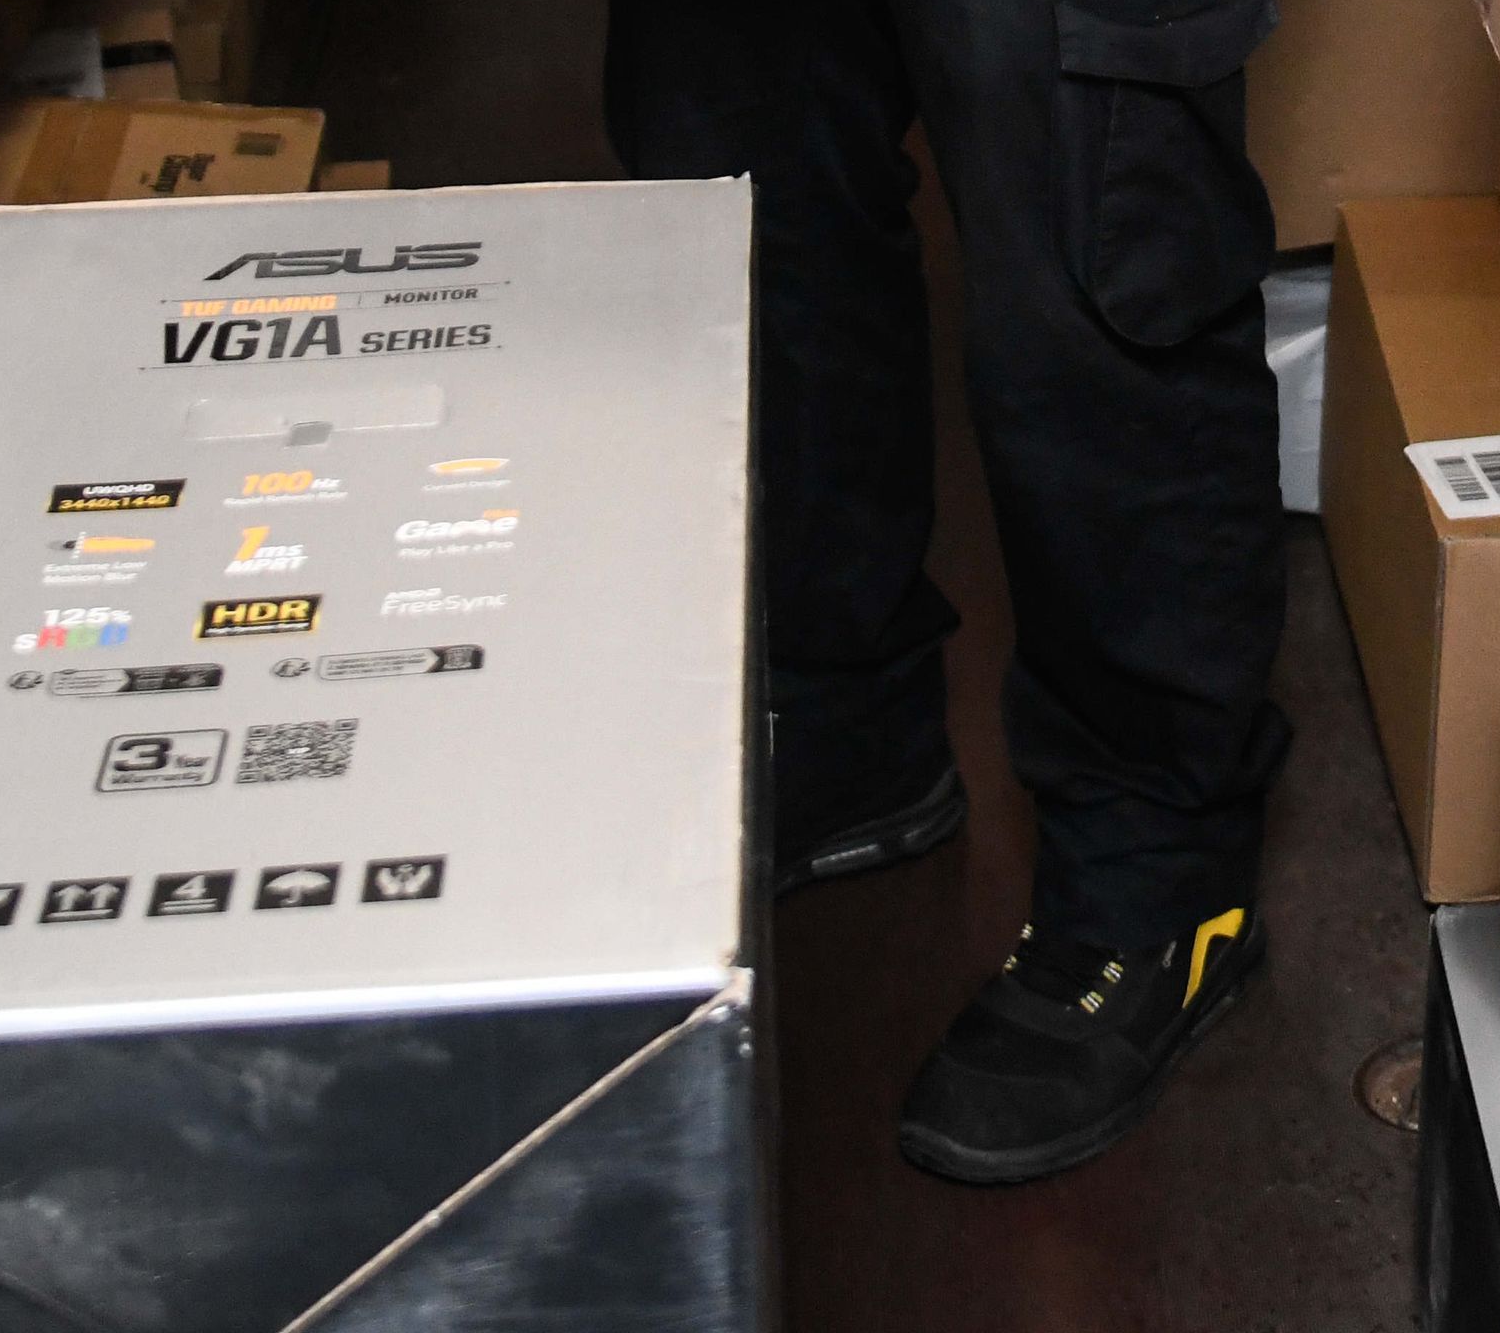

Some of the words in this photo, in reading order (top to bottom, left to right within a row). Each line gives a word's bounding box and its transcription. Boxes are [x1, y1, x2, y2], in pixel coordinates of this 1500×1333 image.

[204, 242, 482, 280] ASUS
[181, 300, 225, 317] TUF
[231, 295, 338, 315] GAMING
[384, 288, 478, 304] MONITOR
[164, 315, 341, 364] VG1A
[359, 324, 492, 354] SERIES
[57, 494, 170, 511] 3440x1440
[44, 606, 132, 626] 125%
[211, 600, 312, 626] HDR
[381, 594, 508, 617] FreeSync
[113, 737, 174, 772] 3
